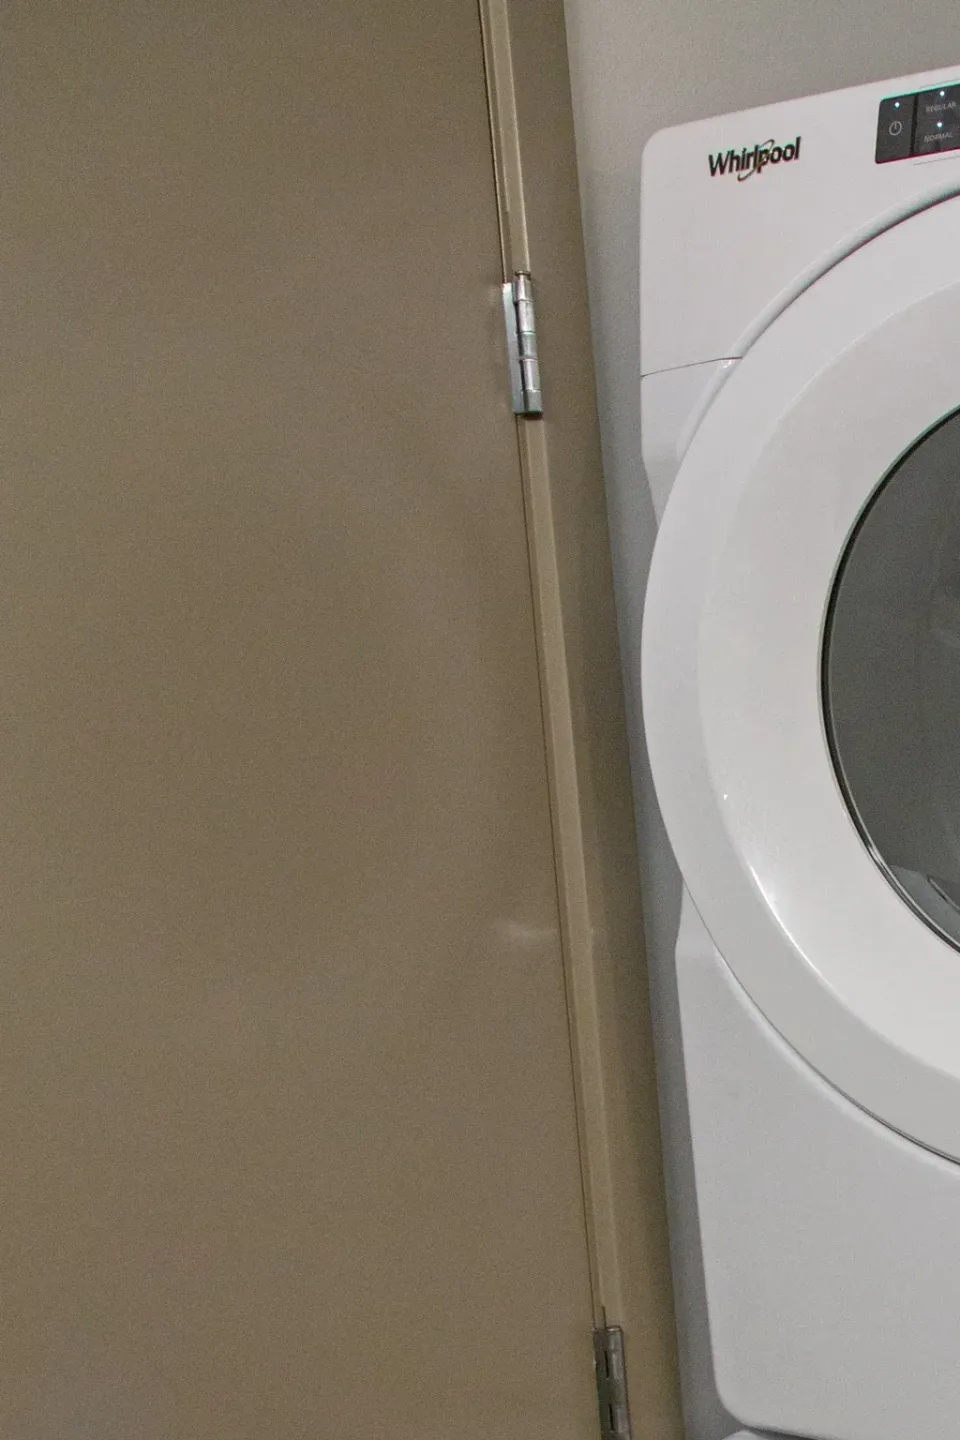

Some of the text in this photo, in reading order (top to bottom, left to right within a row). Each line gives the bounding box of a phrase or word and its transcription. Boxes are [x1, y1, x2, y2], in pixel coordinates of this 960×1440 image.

[926, 101, 957, 113] REGULAR
[924, 132, 953, 143] NORMAL
[708, 136, 801, 180] Whirlpool
